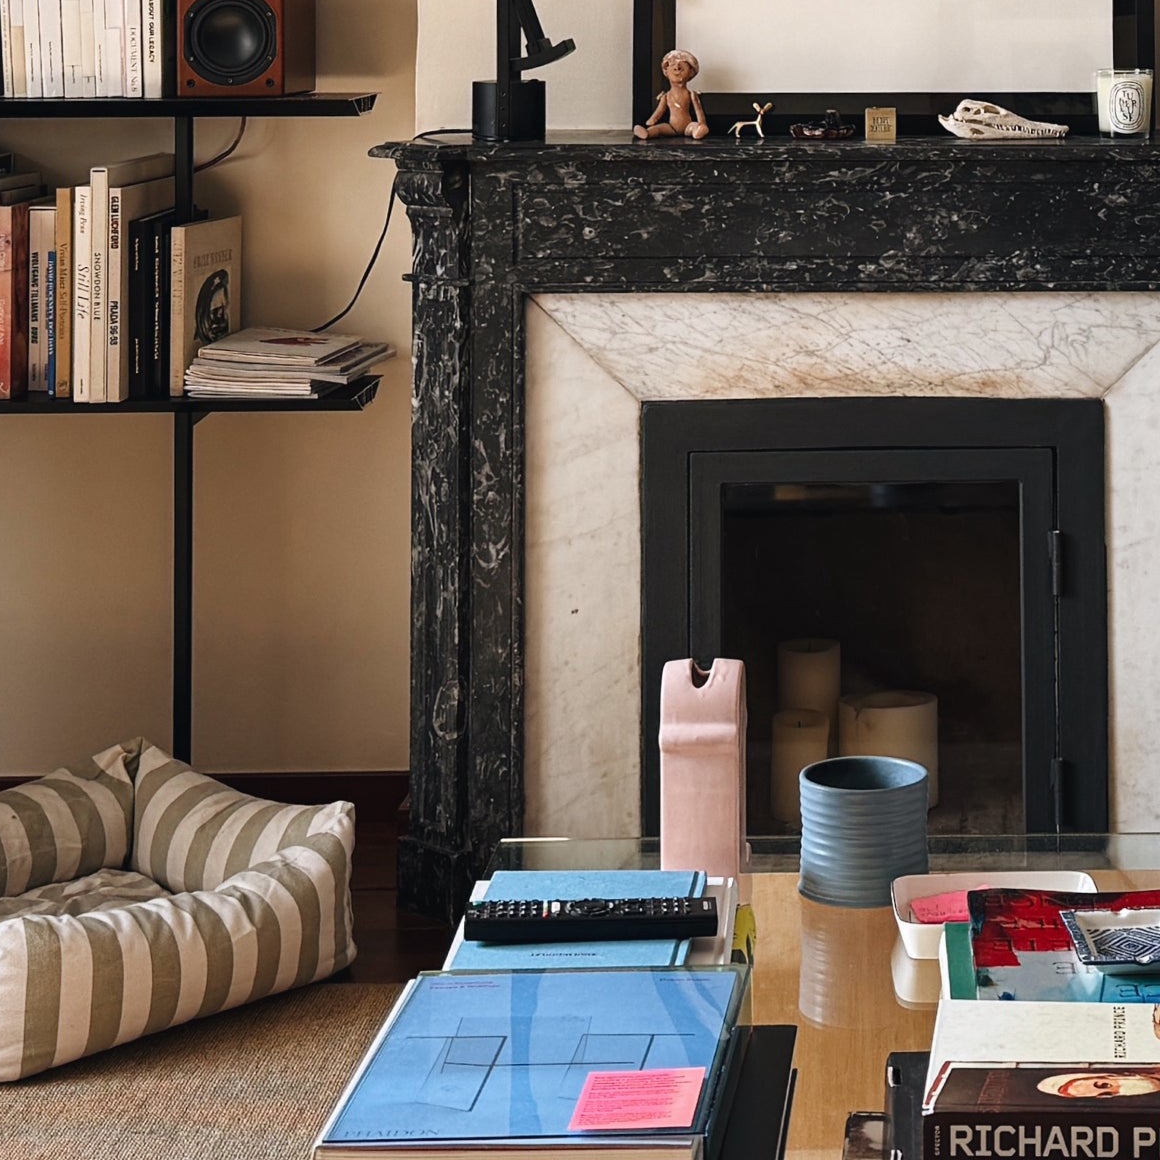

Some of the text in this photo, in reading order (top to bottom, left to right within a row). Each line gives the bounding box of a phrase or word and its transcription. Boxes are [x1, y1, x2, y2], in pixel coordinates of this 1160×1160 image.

[129, 27, 138, 73] DOCUMENT
[78, 193, 87, 234] Irving Penn
[110, 196, 119, 249] GLEN LUCHFORD
[31, 251, 39, 288] WOLFGANG
[59, 243, 67, 267] Vivian
[59, 268, 67, 290] Maier
[76, 263, 90, 319] Still Life
[31, 290, 39, 323] TILLMANS
[93, 302, 101, 321] BLUE
[110, 300, 118, 324] PRADA
[1113, 1006, 1127, 1059] RICHARD PRINCE
[950, 1125, 1160, 1158] RICHARD P
